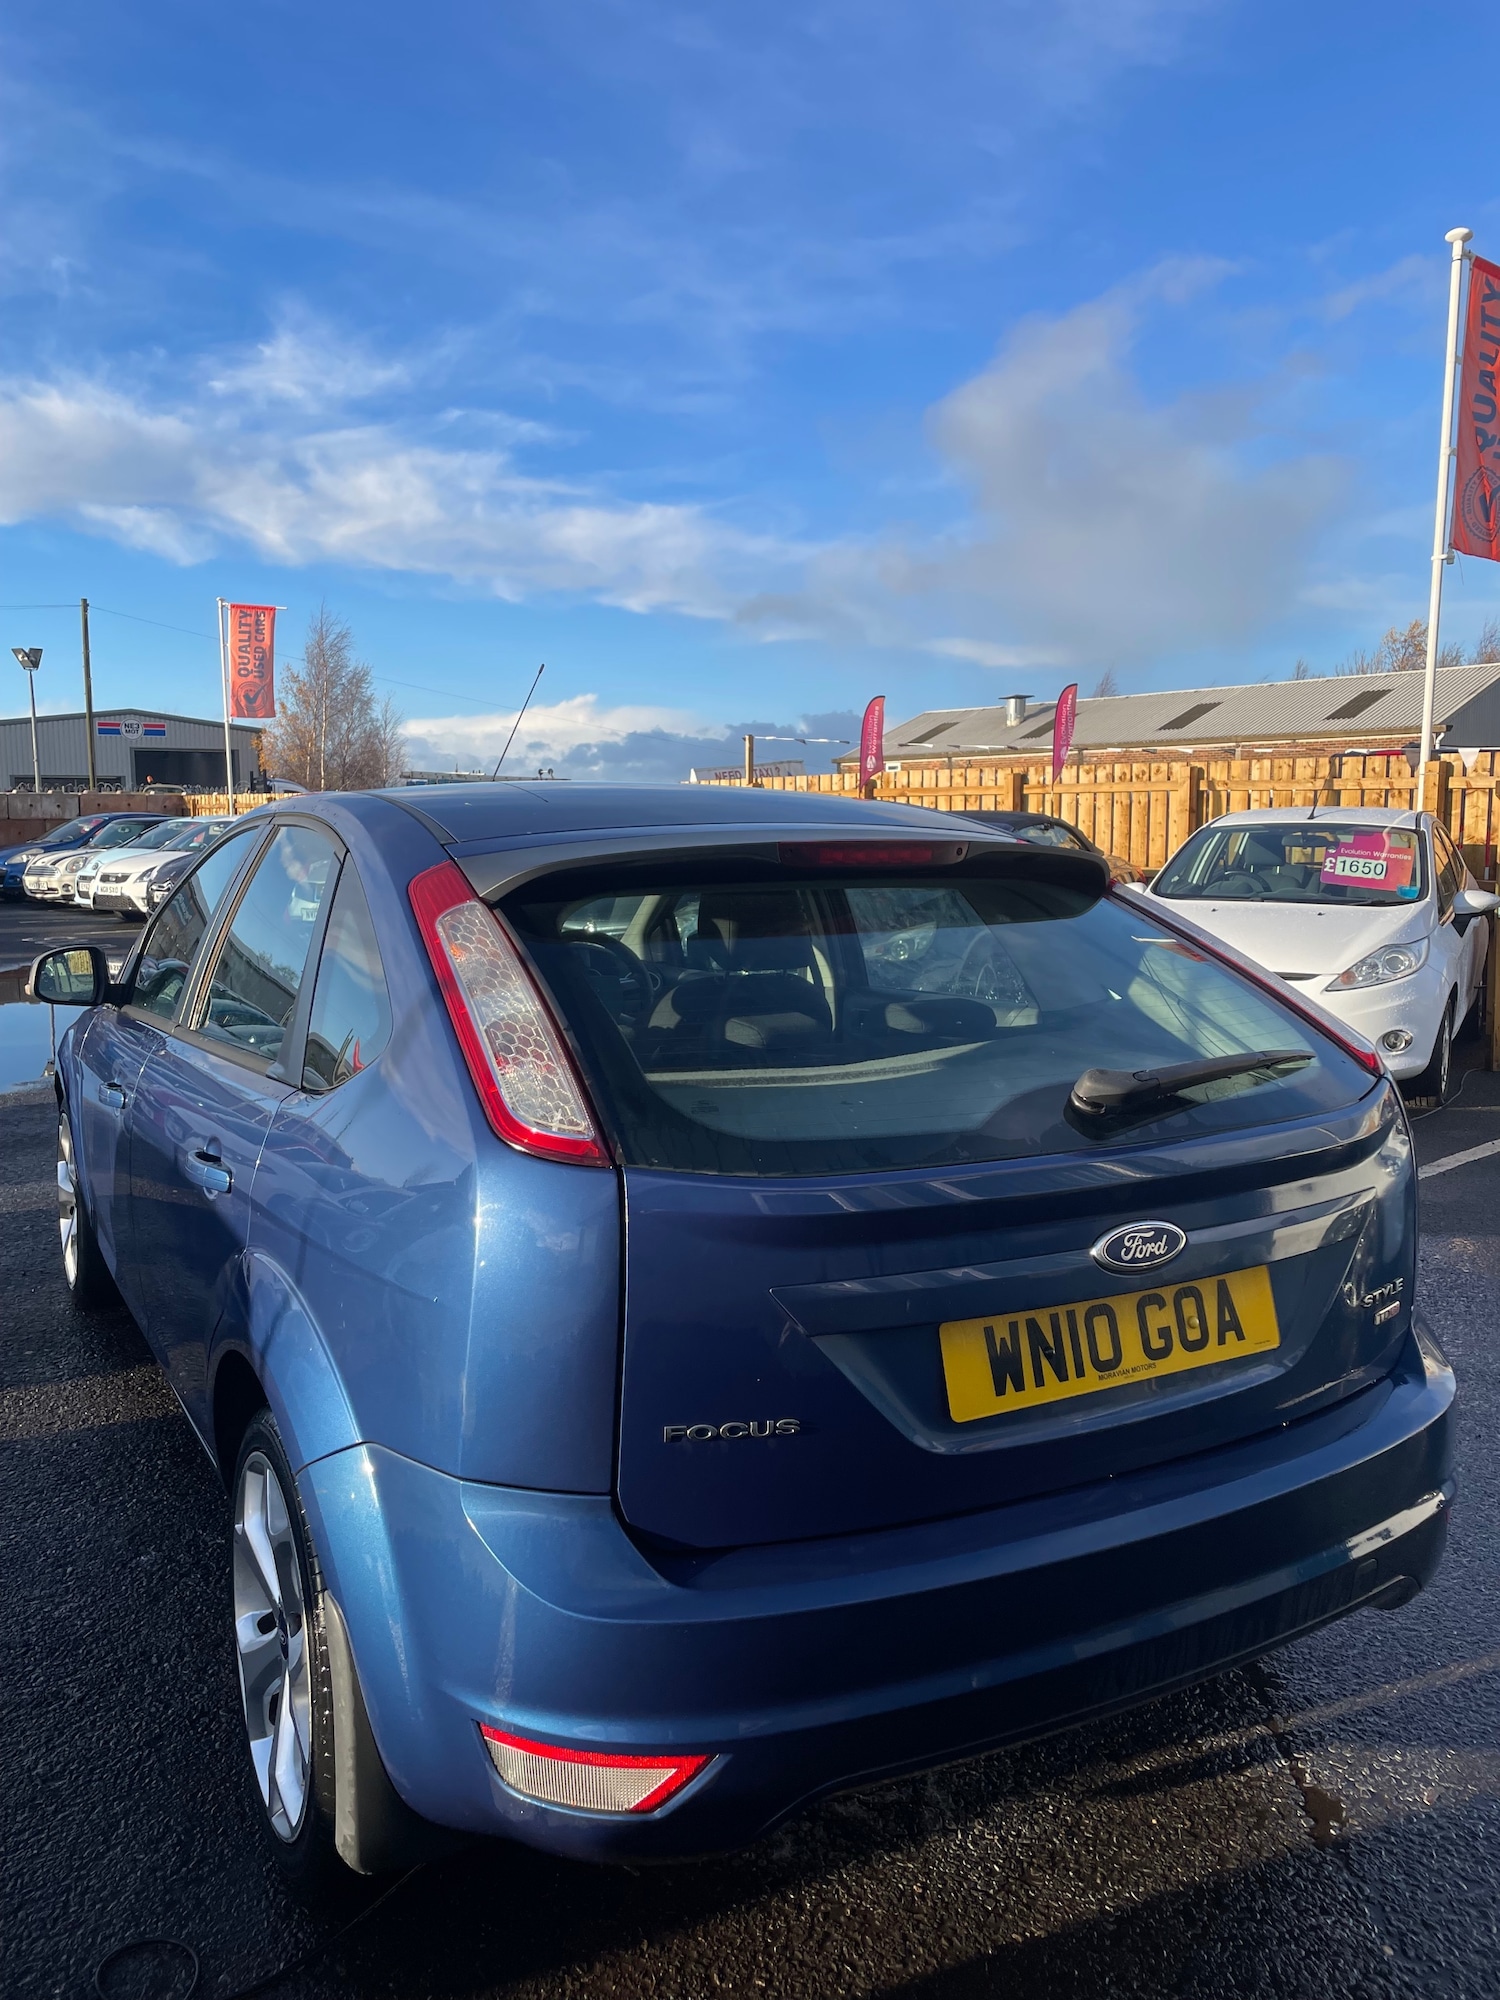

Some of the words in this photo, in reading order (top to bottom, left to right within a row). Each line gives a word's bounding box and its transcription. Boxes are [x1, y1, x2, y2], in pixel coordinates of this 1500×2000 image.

[1472, 275, 1500, 454] QUALITY
[255, 610, 266, 642] CARS
[237, 609, 253, 678] QUALITY
[253, 646, 265, 679] USED
[871, 705, 880, 754] Warranties
[1340, 847, 1372, 856] Evolution
[1372, 850, 1412, 860] Warranties
[1120, 1230, 1168, 1261] Ford
[1361, 1277, 1404, 1308] STYLE
[983, 1302, 1123, 1397] WN10
[1136, 1278, 1246, 1361] GOA
[1098, 1368, 1131, 1381] MORAVIAN
[1131, 1362, 1157, 1373] MOTORS
[663, 1418, 800, 1443] FOCUS
